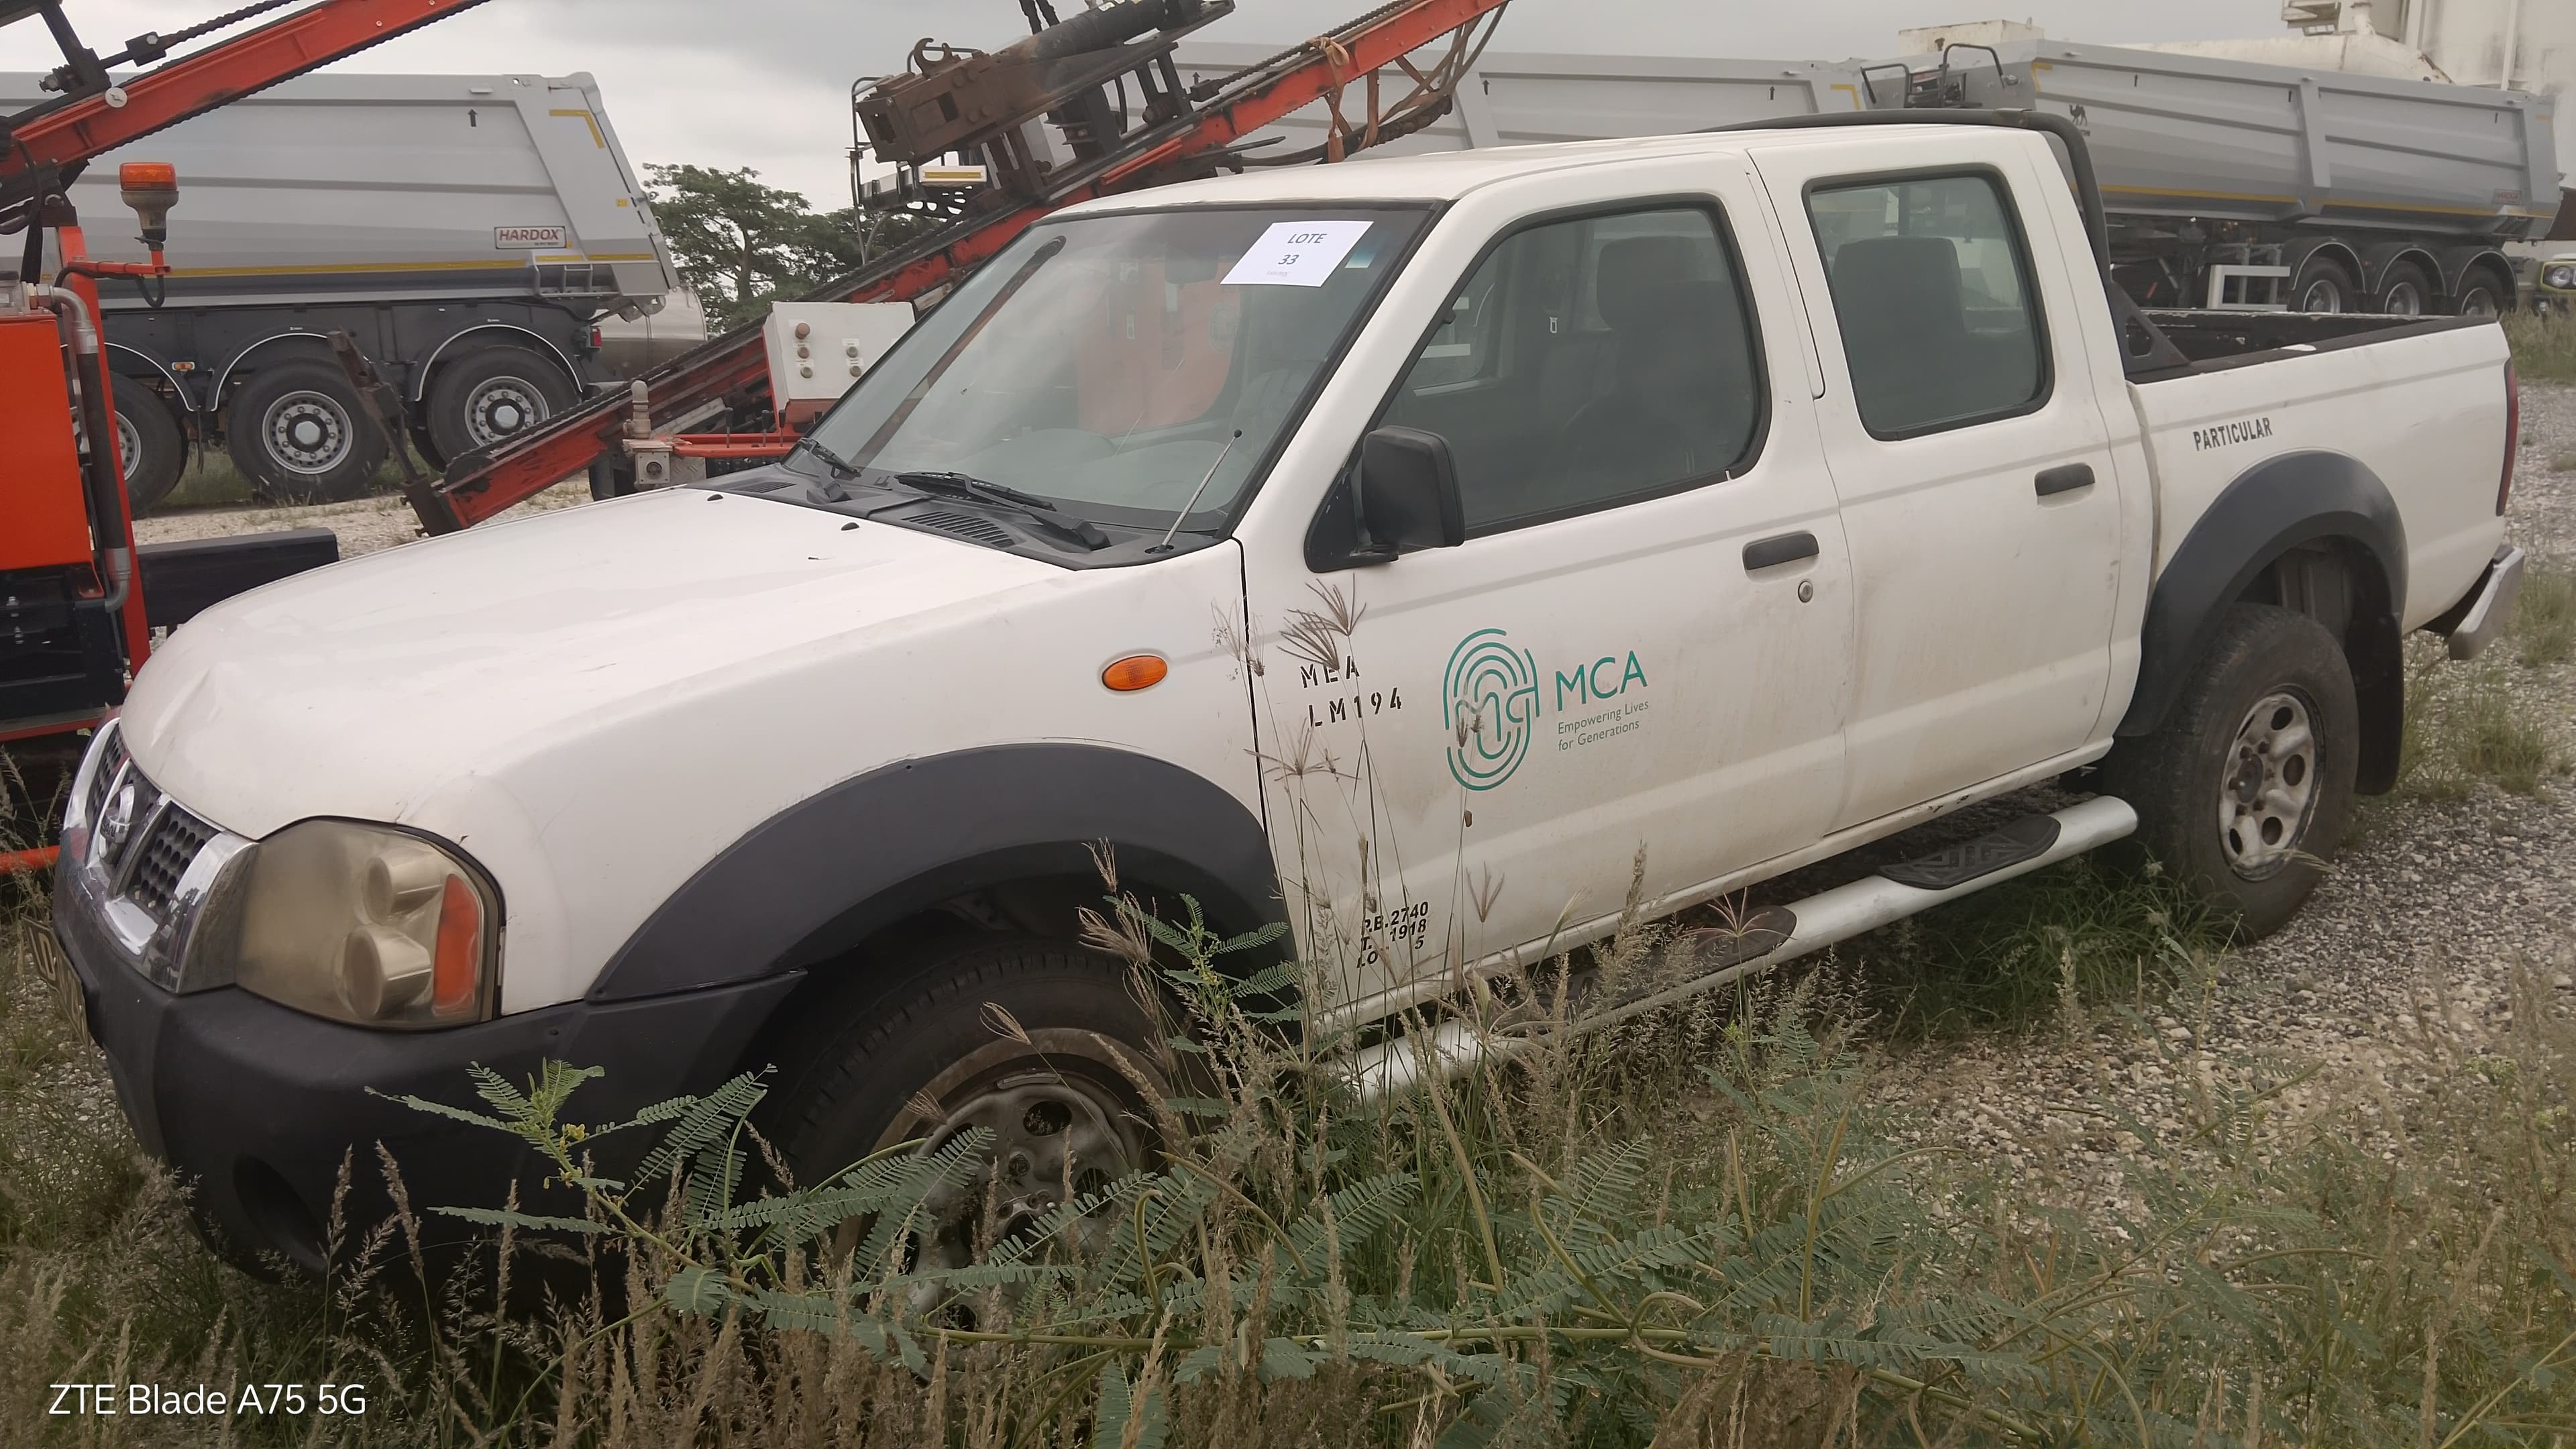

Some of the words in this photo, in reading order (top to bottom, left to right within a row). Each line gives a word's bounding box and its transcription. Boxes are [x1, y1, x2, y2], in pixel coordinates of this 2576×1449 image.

[498, 229, 559, 241] HARDOX
[1287, 233, 1328, 244] LOTE
[1278, 254, 1300, 265] 33
[2193, 417, 2273, 451] PARTICULAR
[1555, 649, 1648, 711] MCA
[1558, 709, 1621, 734] Empowering
[1625, 701, 1649, 715] Lives
[1558, 739, 1574, 751] for
[1577, 720, 1640, 745] Generations
